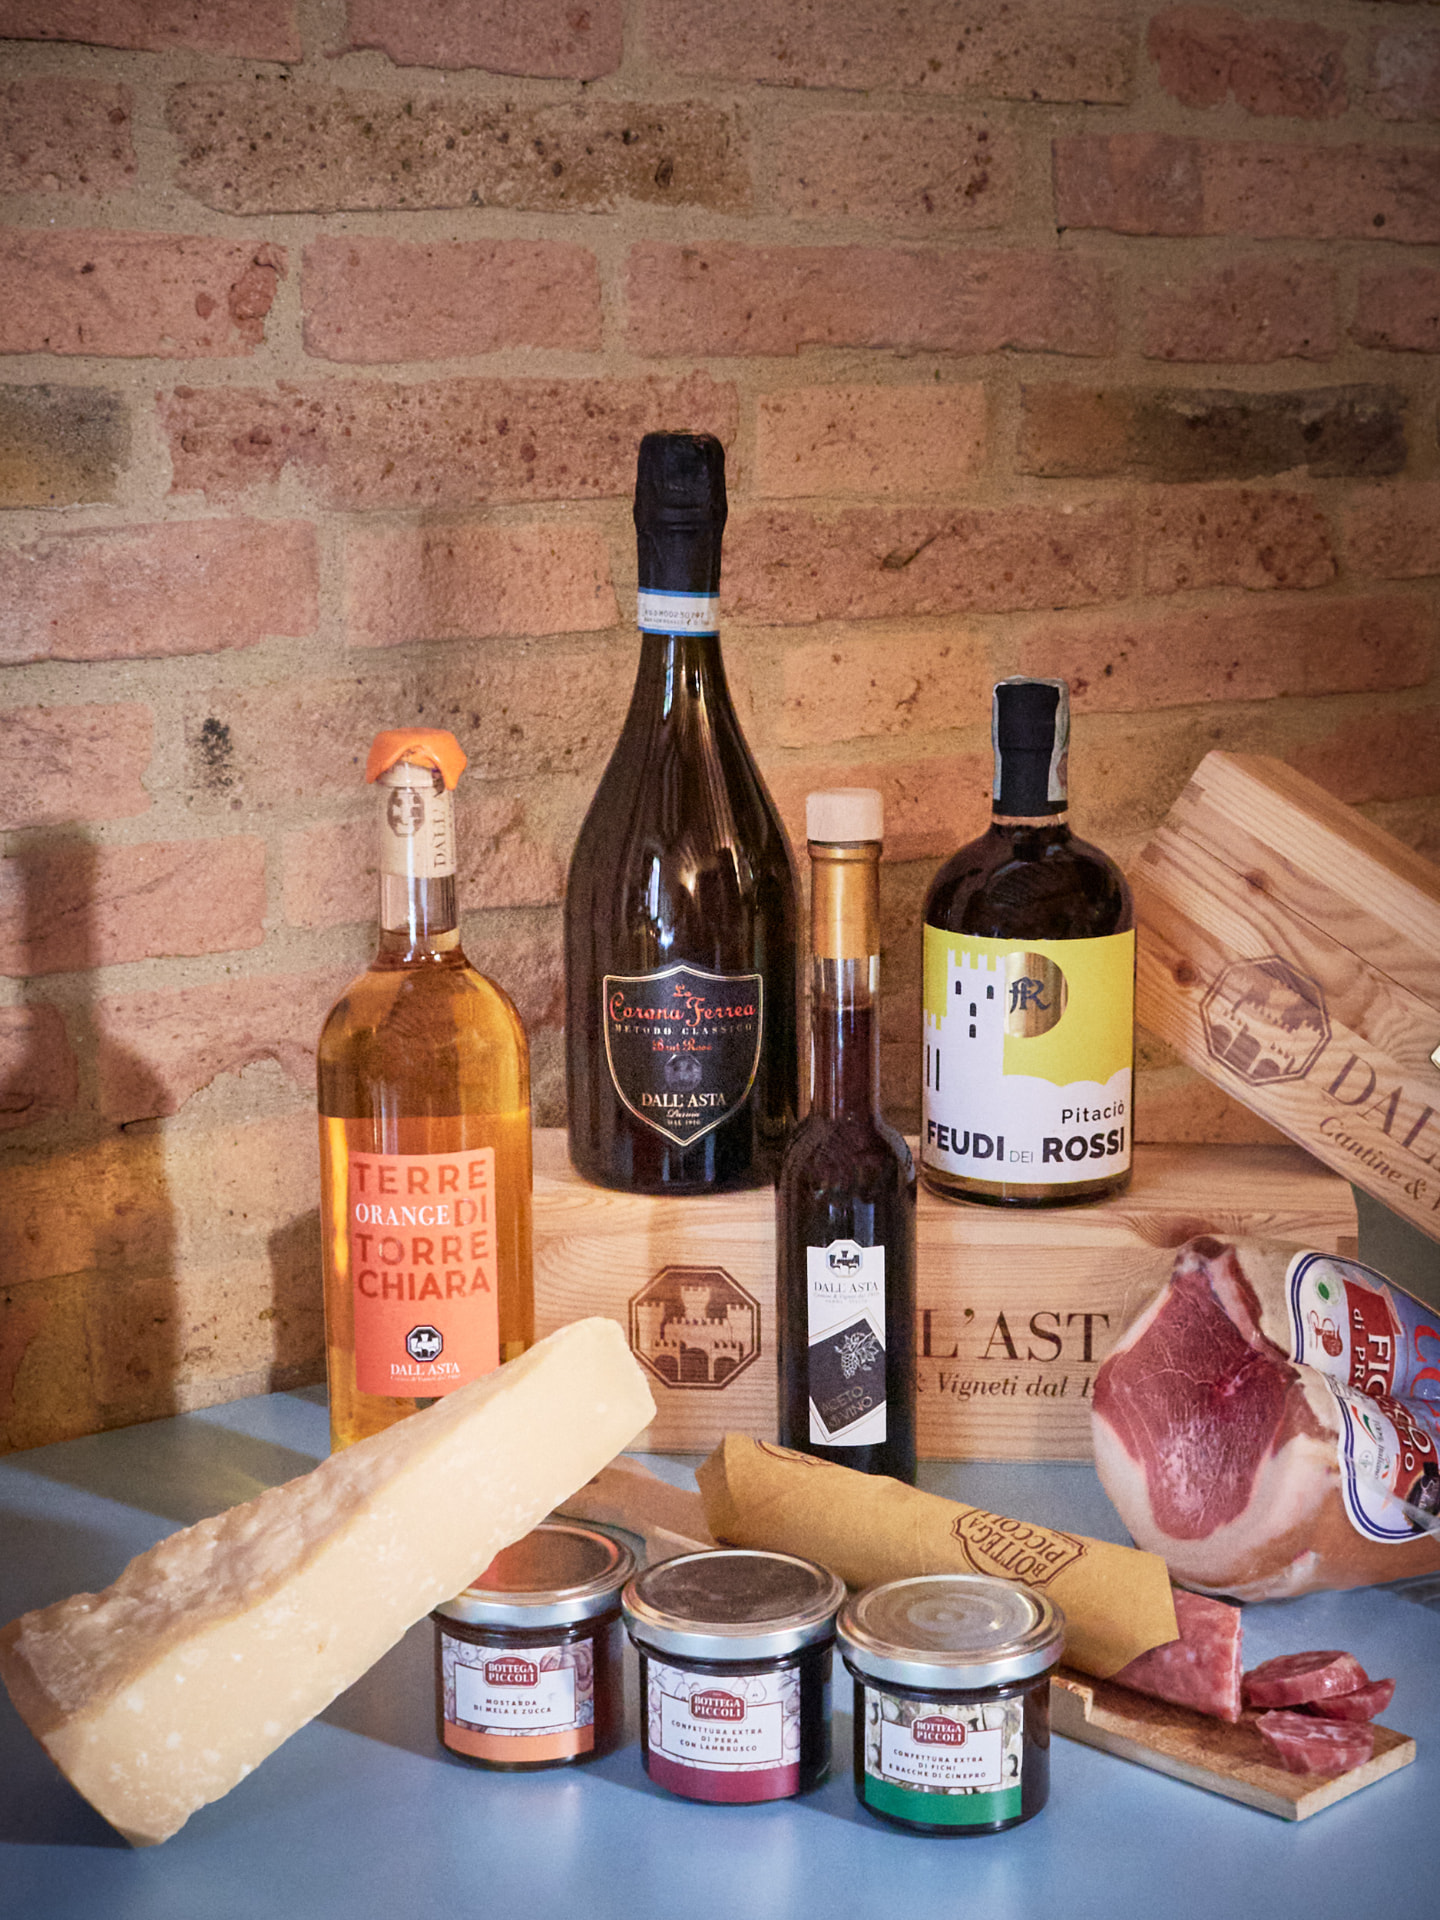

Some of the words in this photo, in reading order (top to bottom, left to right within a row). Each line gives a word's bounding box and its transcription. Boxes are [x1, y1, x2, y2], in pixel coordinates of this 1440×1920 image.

[672, 983, 693, 998] La
[609, 991, 685, 1022] Corona
[685, 996, 756, 1027] Ferrea
[614, 1023, 672, 1036] METODO
[681, 1023, 752, 1036] CLASSICO
[686, 1092, 727, 1108] ASTA
[1061, 1100, 1125, 1124] Pitaciò
[1320, 1050, 1440, 1174] DAL
[927, 1119, 1005, 1162] FEUDI
[1009, 1150, 1034, 1164] DEI
[1042, 1126, 1125, 1164] ROSSI
[1319, 1116, 1402, 1183] Cantine
[1404, 1178, 1427, 1200] &
[353, 1159, 488, 1195] TERRE
[355, 1202, 451, 1227] ORANGE
[453, 1195, 488, 1228] DI
[354, 1230, 490, 1266] TORRE
[357, 1265, 491, 1301] CHIARA
[850, 1281, 879, 1293] ASTA
[917, 1307, 1111, 1363] L'AST
[427, 1361, 461, 1376] ASTA
[938, 1371, 1019, 1401] Vigneti
[1026, 1374, 1068, 1398] dal
[819, 1385, 864, 1415] ACETO
[839, 1395, 873, 1421] VINO
[967, 1517, 1049, 1578] BOTTEGA
[488, 1663, 535, 1673] BOTTEGA
[488, 1672, 535, 1683] PICCOLI
[486, 1698, 537, 1706] MOSTARDA
[694, 1695, 741, 1708] BOTTEGA
[486, 1706, 509, 1714] MELA
[522, 1707, 551, 1715] ZUCCA
[694, 1705, 741, 1718] PICCOLI
[671, 1720, 727, 1735] CONFETTURA
[916, 1721, 962, 1733] BOTTEGA
[916, 1731, 961, 1742] PICCOLI
[680, 1739, 696, 1748] CON
[700, 1744, 757, 1752] LAMBRUSCO
[893, 1748, 949, 1763] CONFETTURA
[896, 1765, 928, 1777] BACCHE
